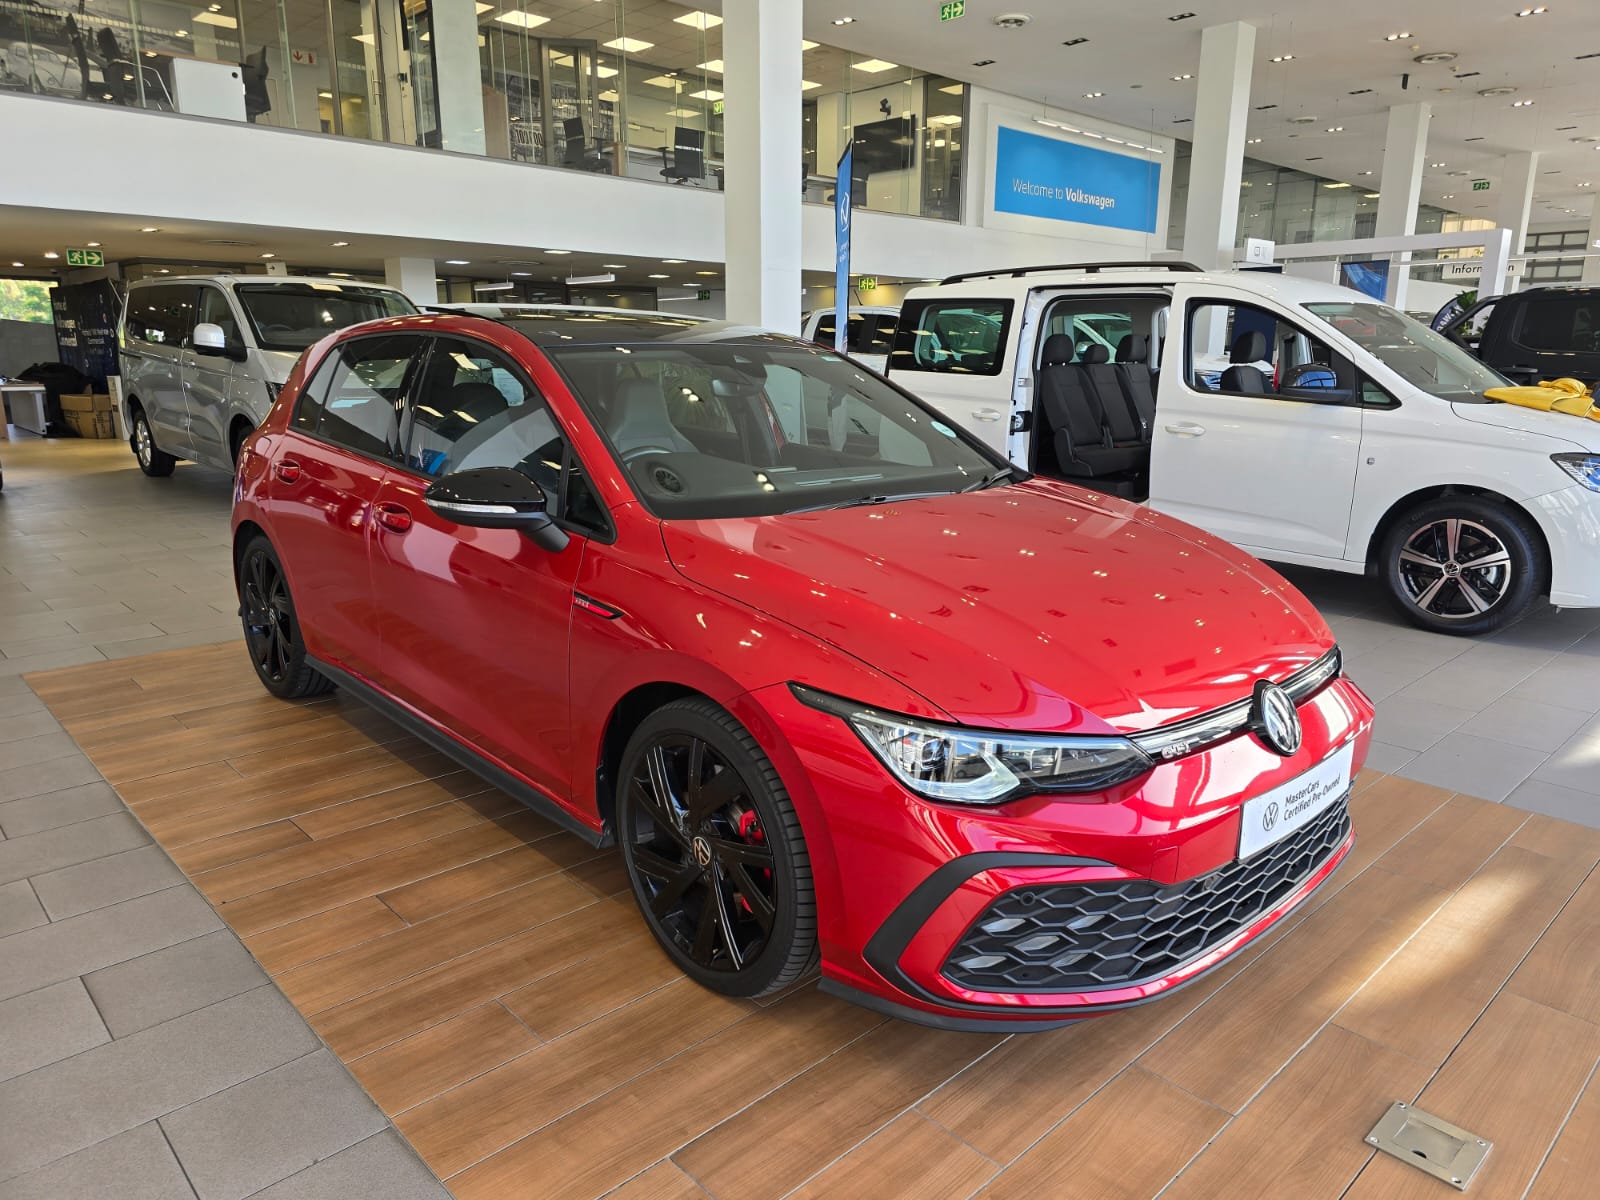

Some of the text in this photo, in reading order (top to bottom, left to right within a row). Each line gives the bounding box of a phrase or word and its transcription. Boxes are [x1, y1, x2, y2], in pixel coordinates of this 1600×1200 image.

[1012, 178, 1115, 210] Welcome to Volkswagen
[1161, 741, 1191, 759] GTI
[1283, 772, 1341, 821] Certified Pre-Owned
[1284, 779, 1320, 807] MasterCars
